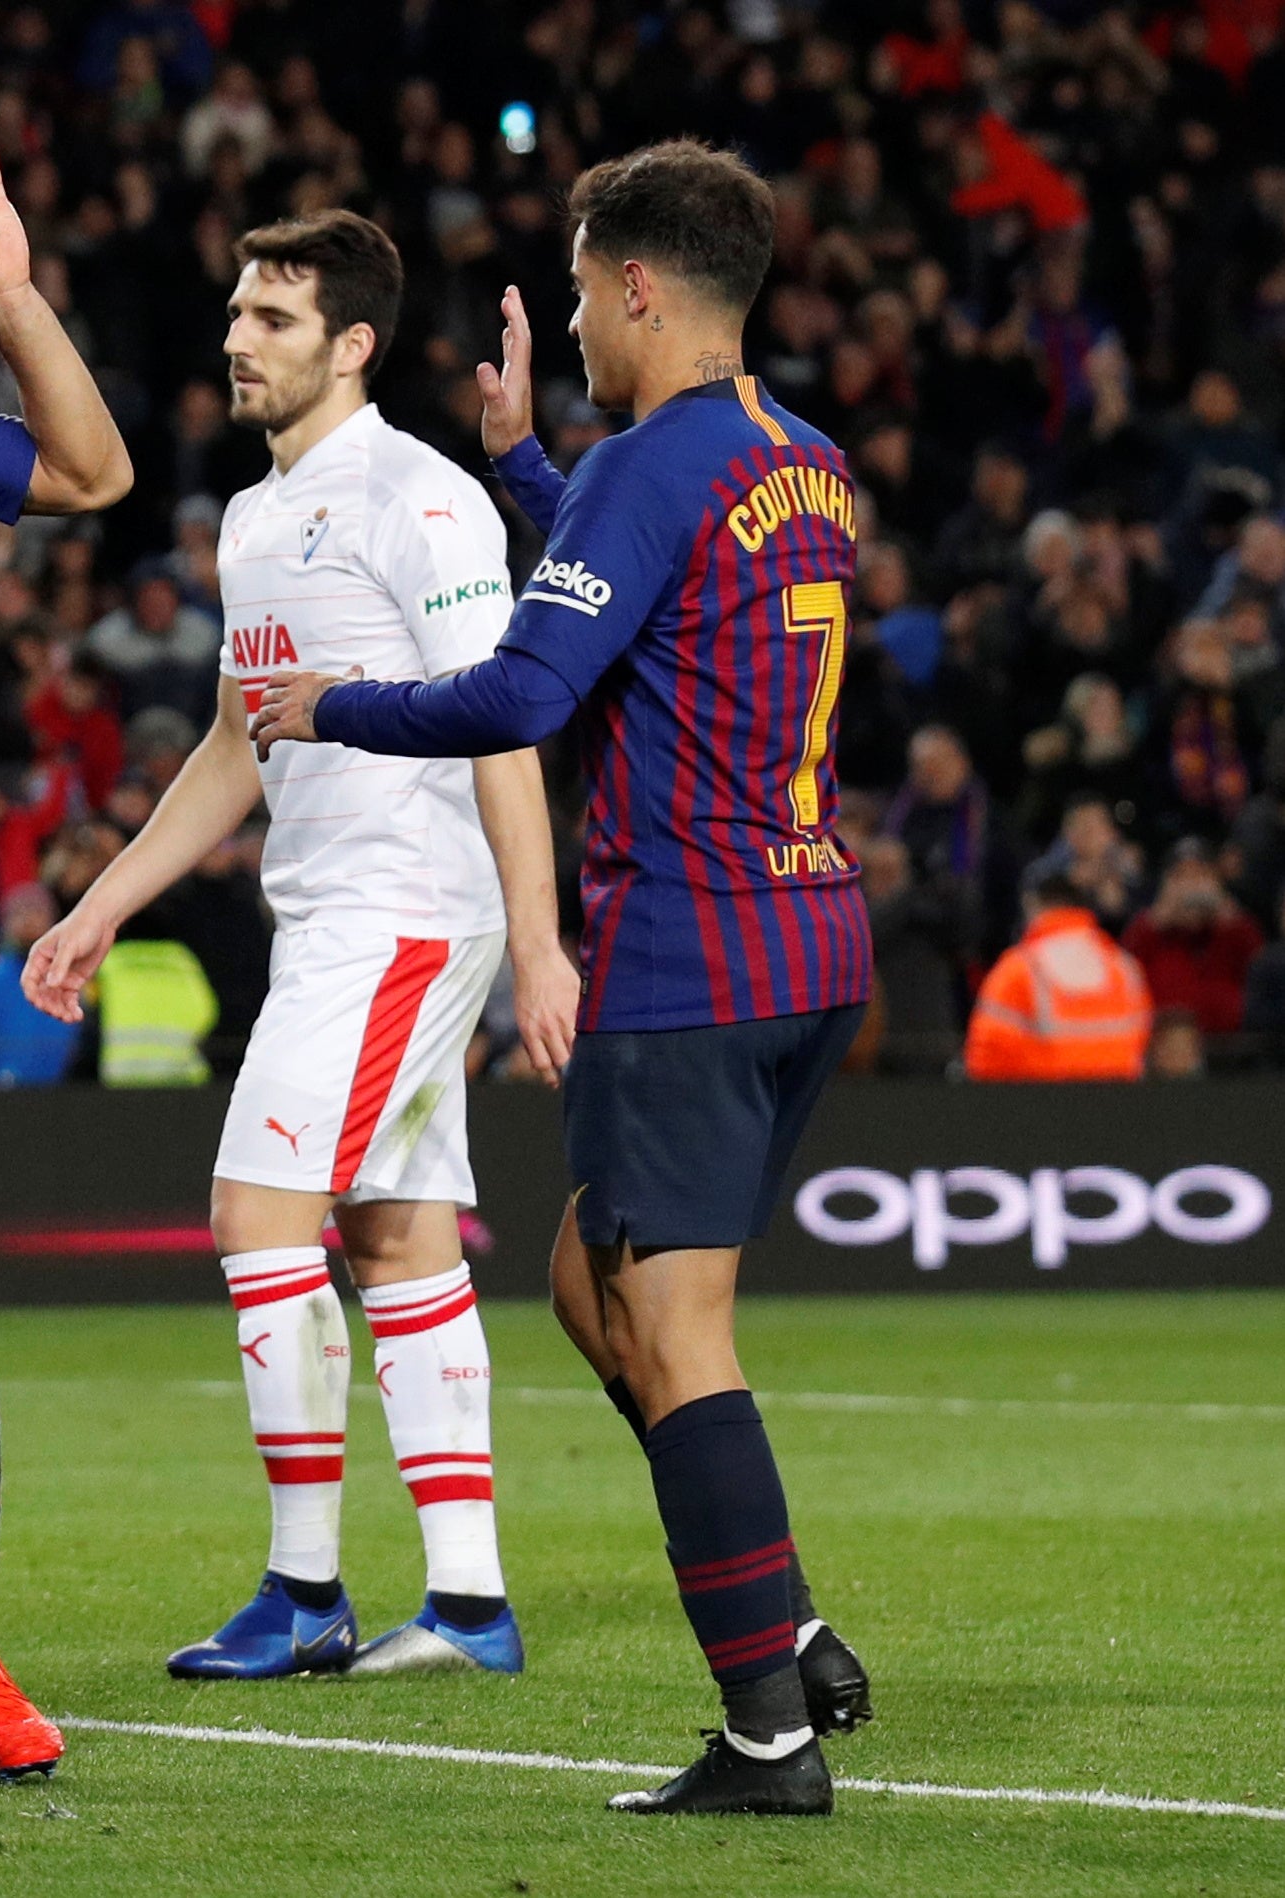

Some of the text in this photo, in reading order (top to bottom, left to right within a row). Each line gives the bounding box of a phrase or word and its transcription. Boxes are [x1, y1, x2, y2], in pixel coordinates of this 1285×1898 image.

[532, 553, 613, 607] beko
[781, 581, 847, 834] 7
[794, 1164, 1272, 1270] oppo
